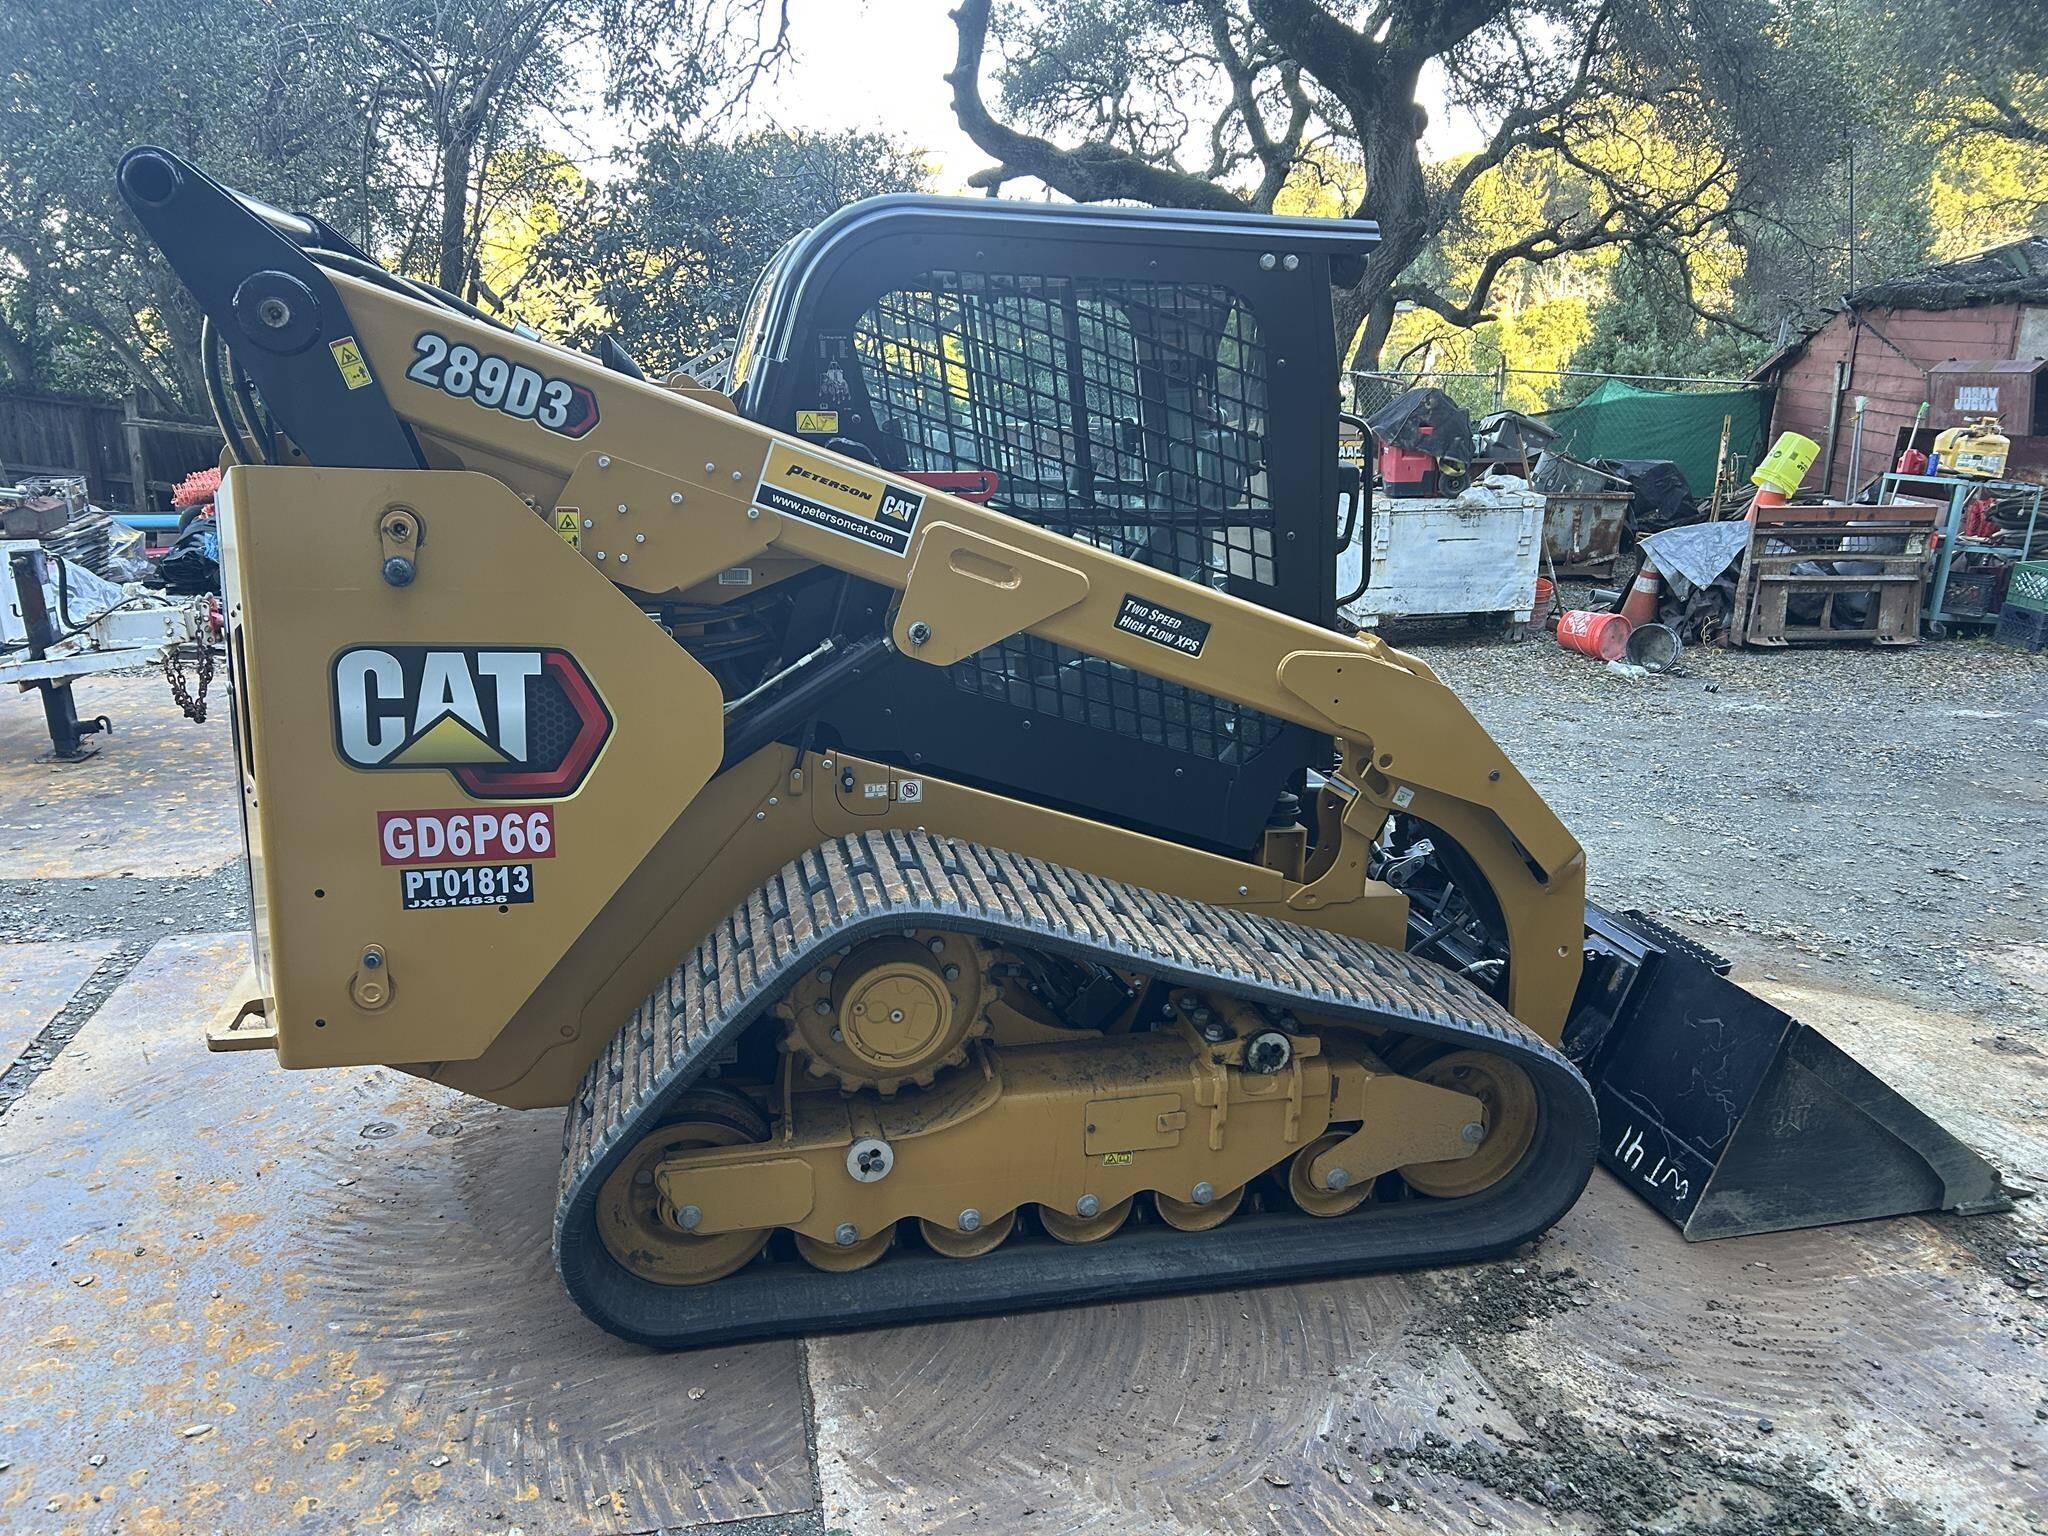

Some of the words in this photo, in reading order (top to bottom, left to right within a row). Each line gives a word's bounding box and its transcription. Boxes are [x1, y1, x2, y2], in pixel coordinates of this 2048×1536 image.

[409, 334, 573, 428] 289D3
[785, 464, 873, 501] PETERSON
[772, 493, 894, 544] www.petersoncat.com
[882, 495, 916, 522] CAT
[1174, 635, 1200, 652] XPS
[337, 650, 542, 764] CAT
[383, 812, 551, 859] GD6P66
[405, 865, 530, 899] PT01813
[408, 895, 508, 909] JX914836
